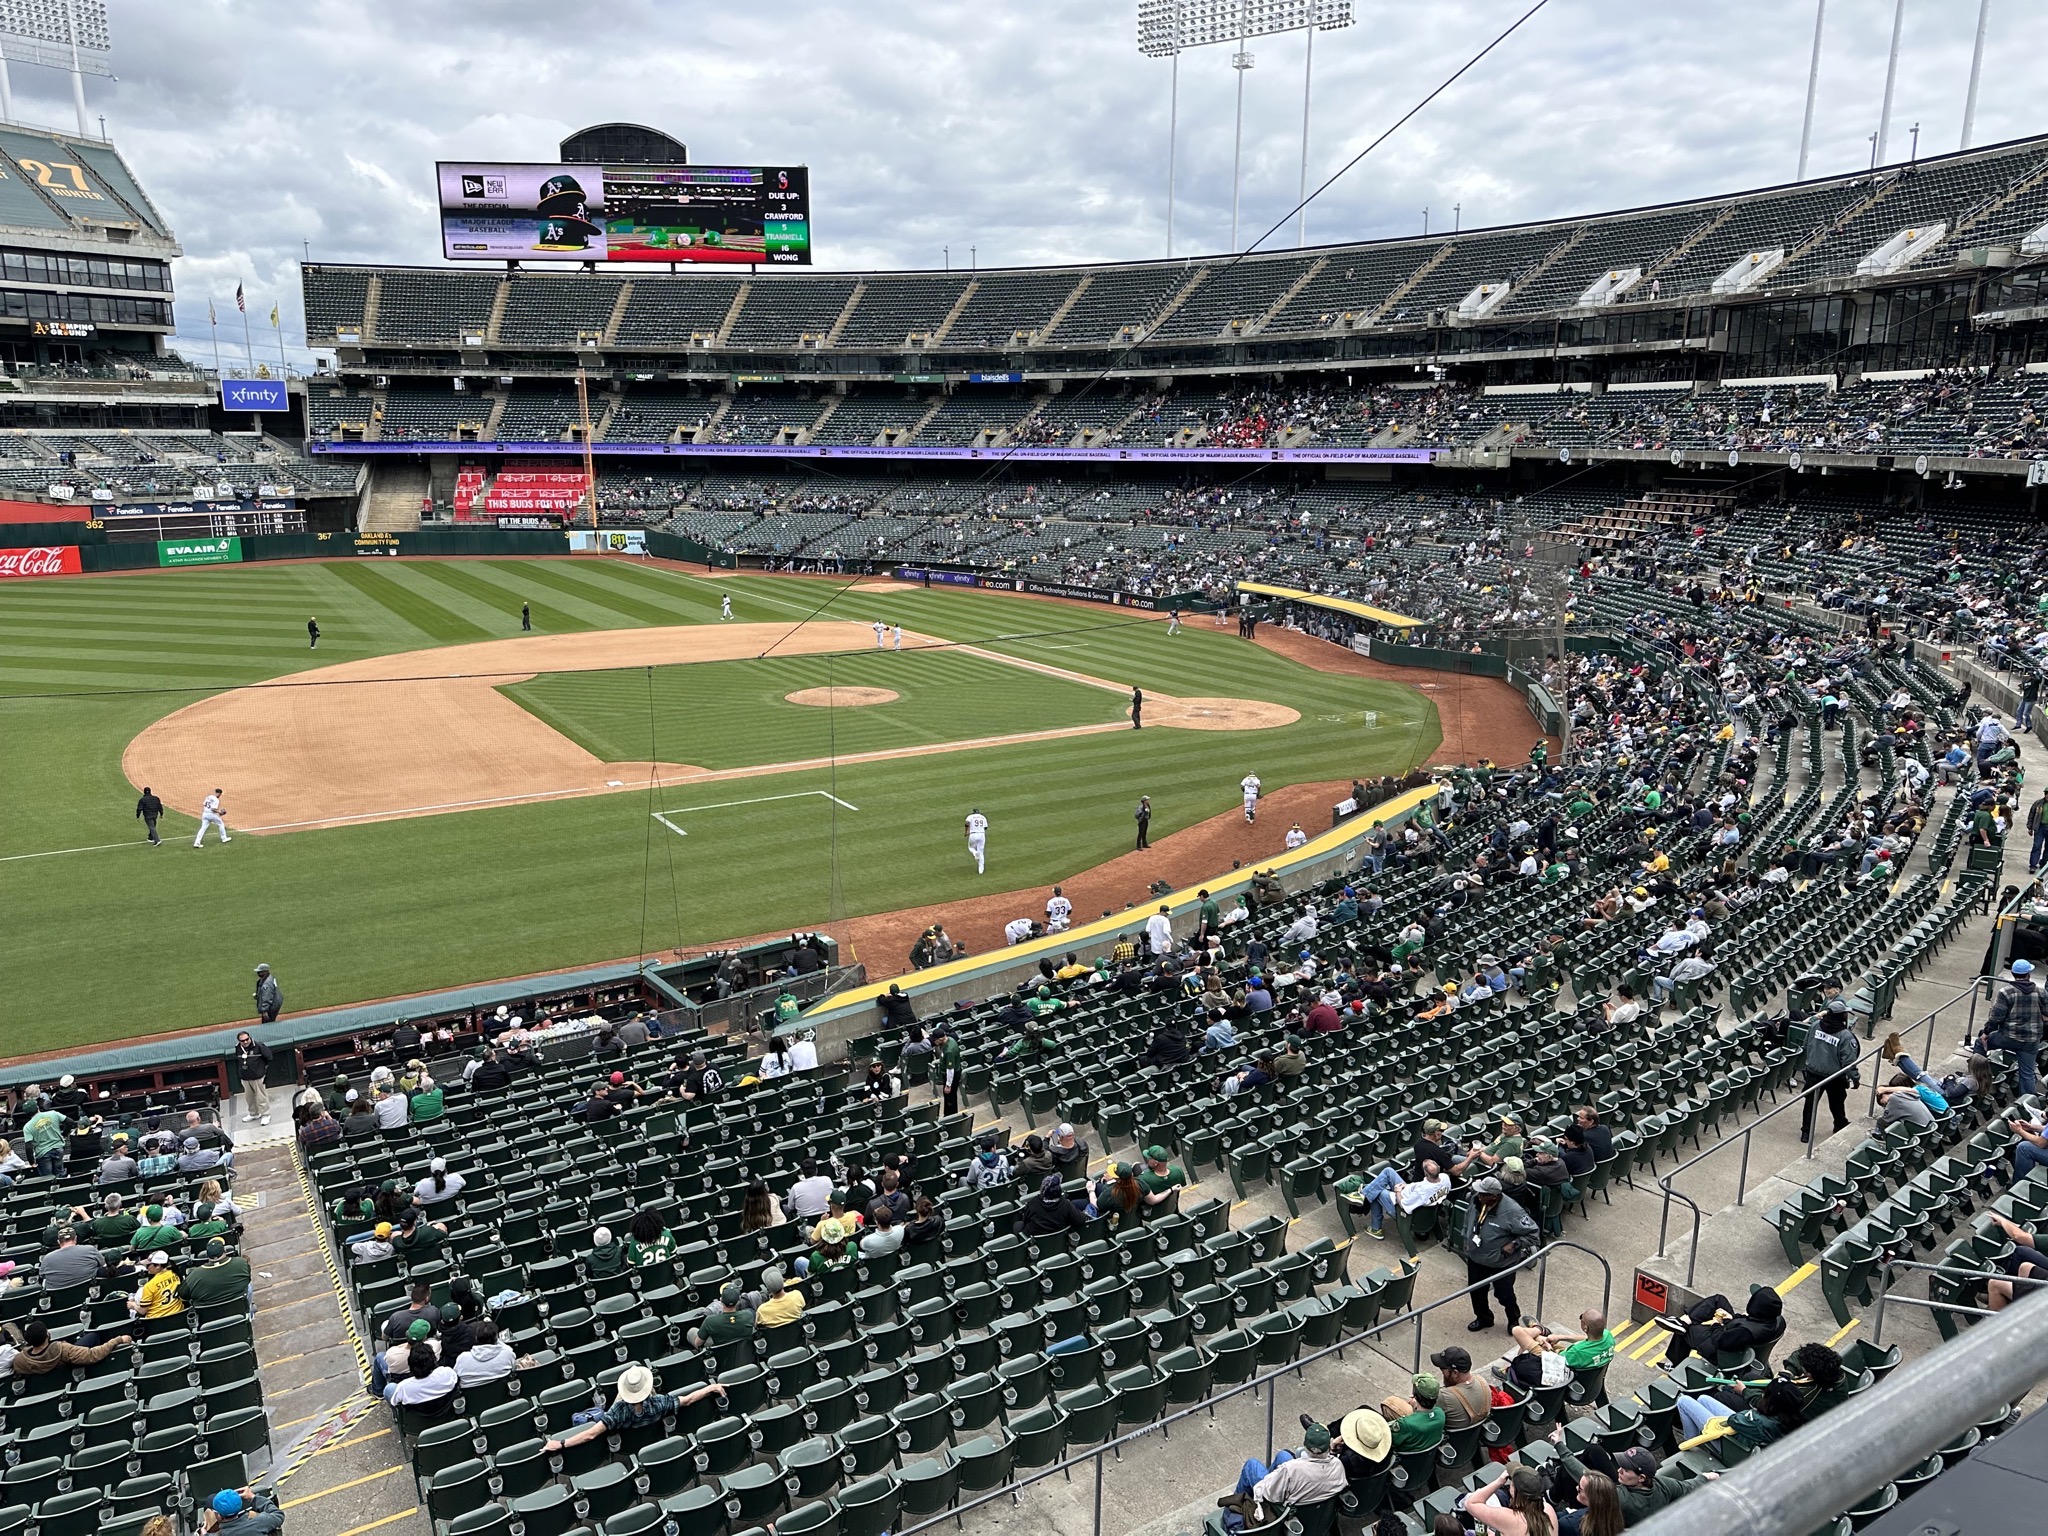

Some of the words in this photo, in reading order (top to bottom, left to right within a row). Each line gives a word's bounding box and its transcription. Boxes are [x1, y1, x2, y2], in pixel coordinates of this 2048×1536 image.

[18, 158, 90, 192] 27
[50, 187, 105, 201] HUNTER
[768, 192, 785, 200] DUE
[786, 192, 800, 200] UP:
[764, 212, 804, 220] CRAWFORD
[232, 388, 278, 404] xfinity
[50, 486, 72, 500] SELL
[194, 488, 214, 499] SELL
[488, 499, 508, 508] THIS
[511, 500, 534, 508] BUDS
[536, 500, 553, 508] FOR
[554, 500, 572, 509] YOU
[86, 520, 104, 529] 362
[318, 532, 332, 540] 367
[611, 534, 625, 545] 811
[167, 546, 193, 555] EVA
[194, 545, 215, 553] AIR
[904, 570, 920, 578] xfinity
[954, 574, 970, 583] xfinity
[978, 578, 1010, 589] ubeo.com
[1043, 586, 1067, 596] Technology
[1067, 589, 1087, 598] Solutions
[1124, 596, 1154, 609] ubeo.com
[1055, 906, 1066, 915] 33
[1814, 1029, 1840, 1046] SECURITY
[984, 1169, 1006, 1187] 24
[642, 1248, 666, 1264] 26
[1638, 1274, 1666, 1299] 122
